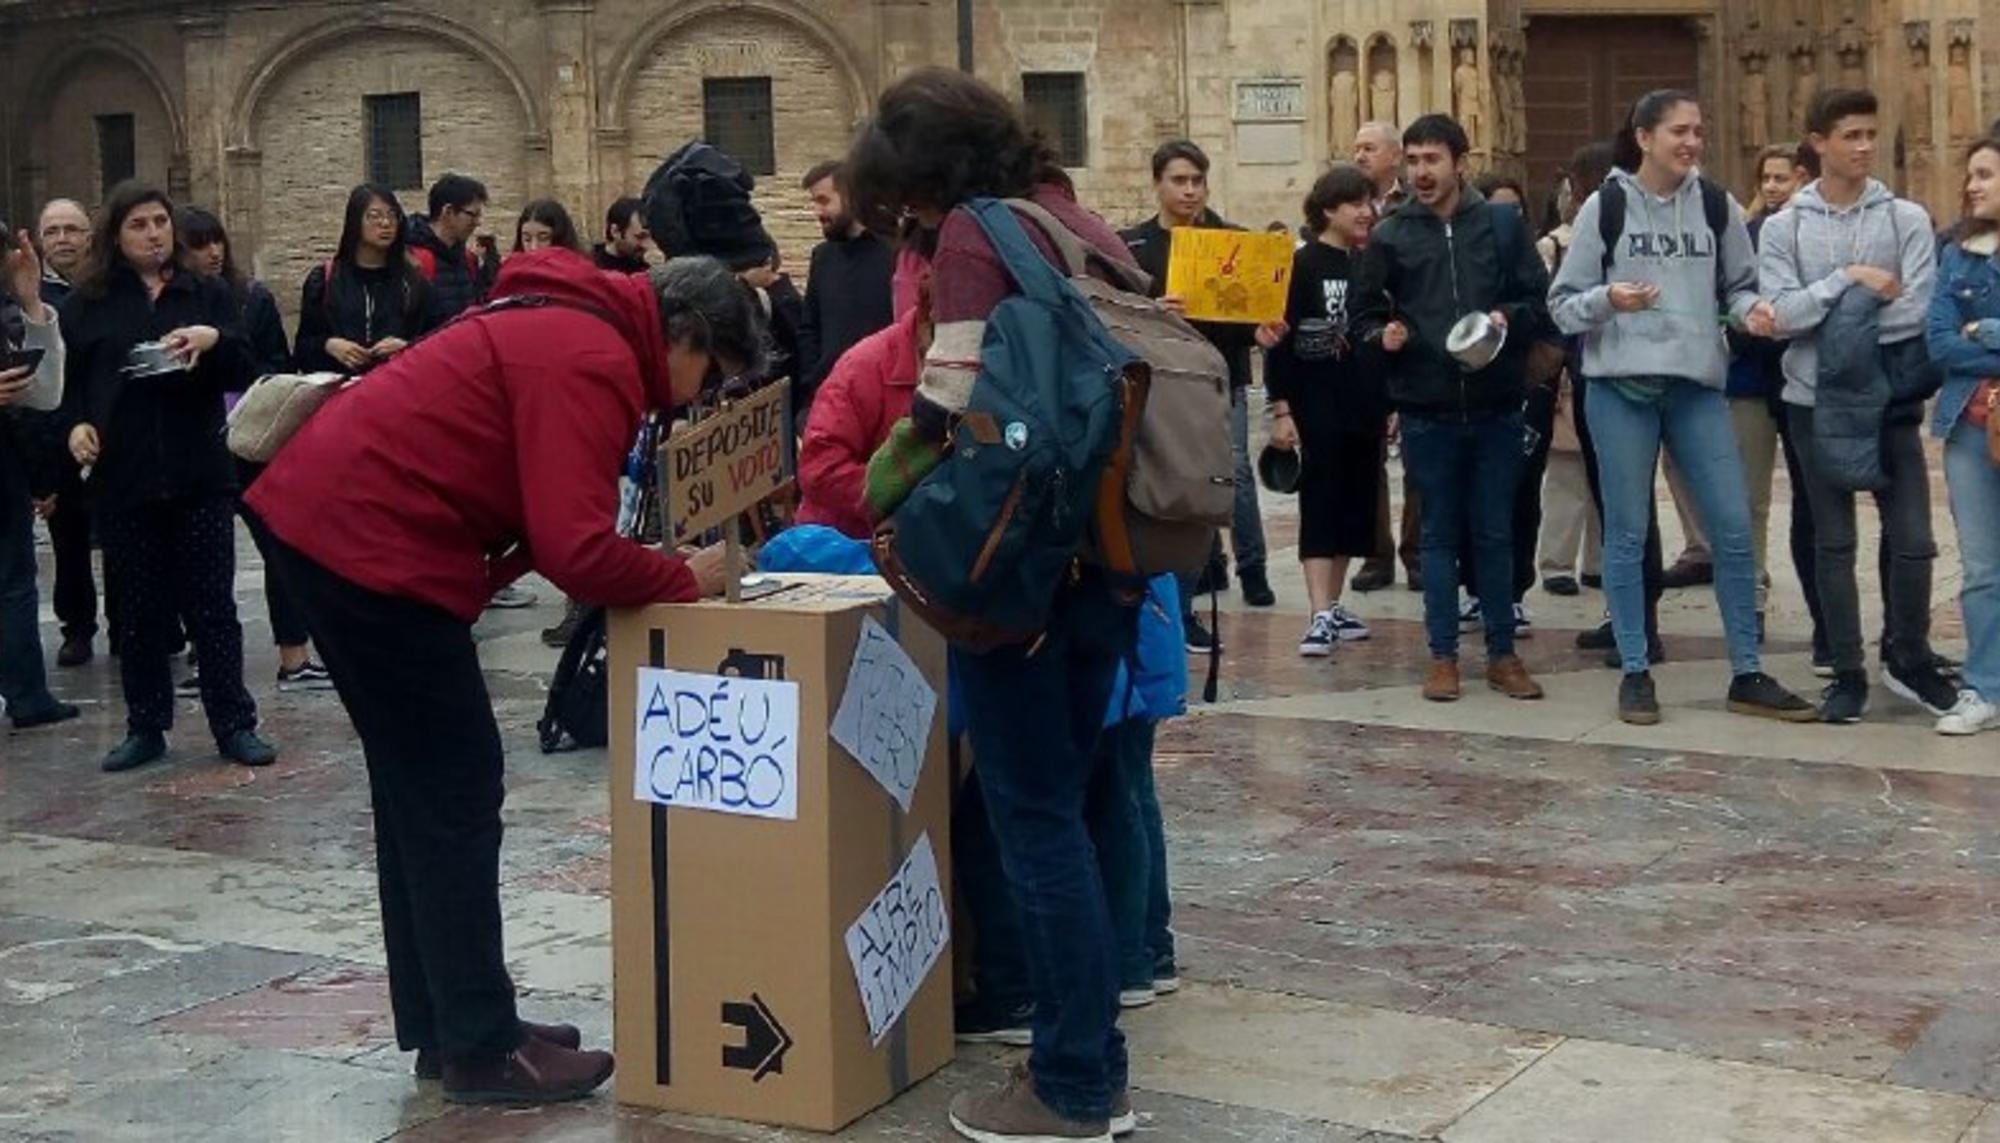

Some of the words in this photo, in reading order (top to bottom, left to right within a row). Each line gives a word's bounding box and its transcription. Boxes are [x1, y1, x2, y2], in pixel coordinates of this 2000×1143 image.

[676, 400, 782, 481] DEPOSITE
[687, 480, 714, 516] SU
[728, 440, 781, 492] VOTO
[641, 682, 770, 745] ADÉU
[650, 735, 788, 810] CARBÓ
